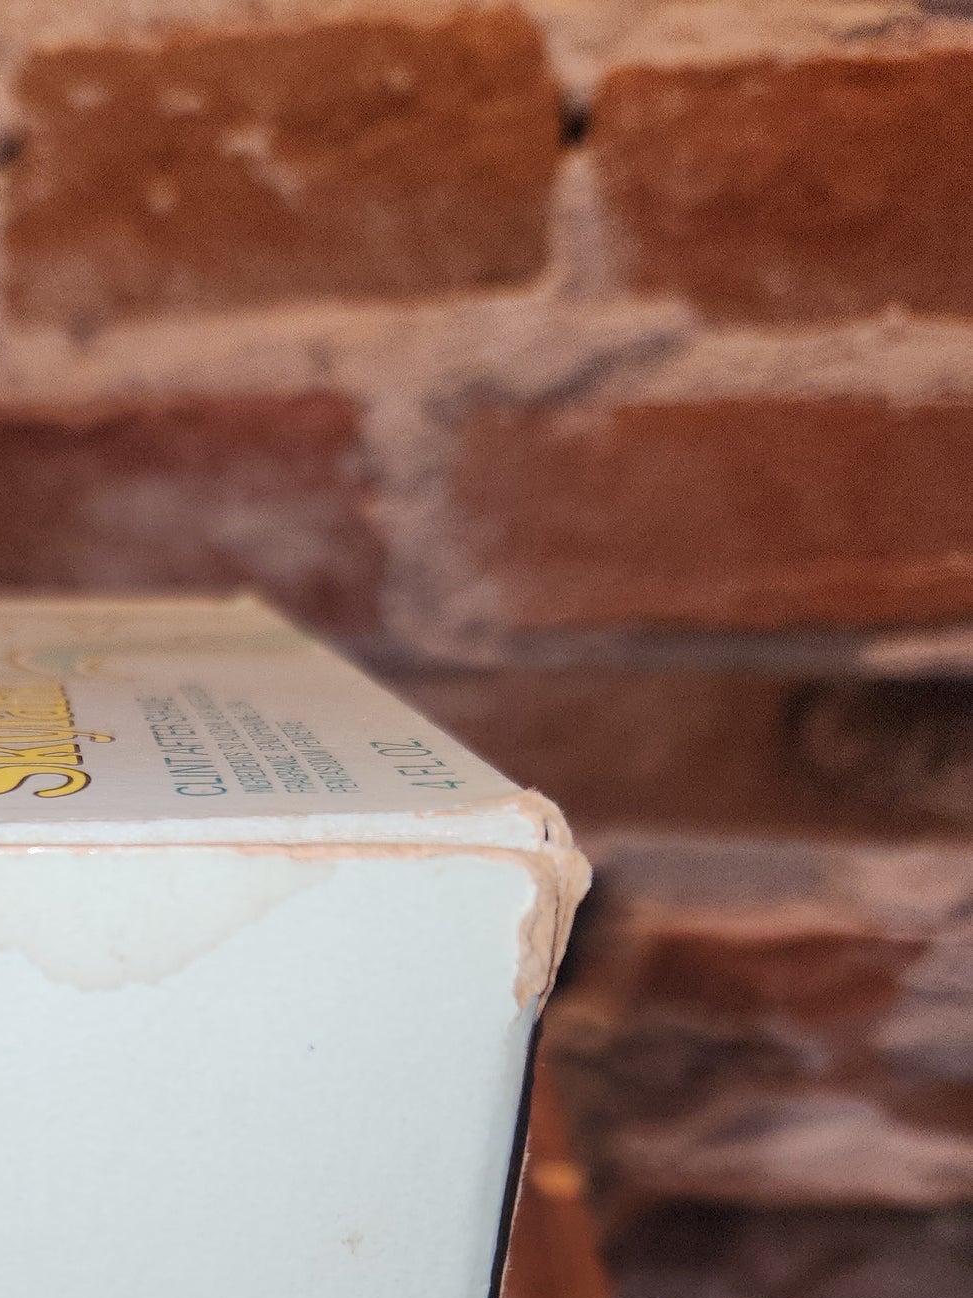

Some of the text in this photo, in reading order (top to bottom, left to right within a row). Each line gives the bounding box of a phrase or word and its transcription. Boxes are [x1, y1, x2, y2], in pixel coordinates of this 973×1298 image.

[148, 723, 209, 755] AFTER
[164, 757, 227, 796] CLINT
[410, 780, 467, 790] 4
